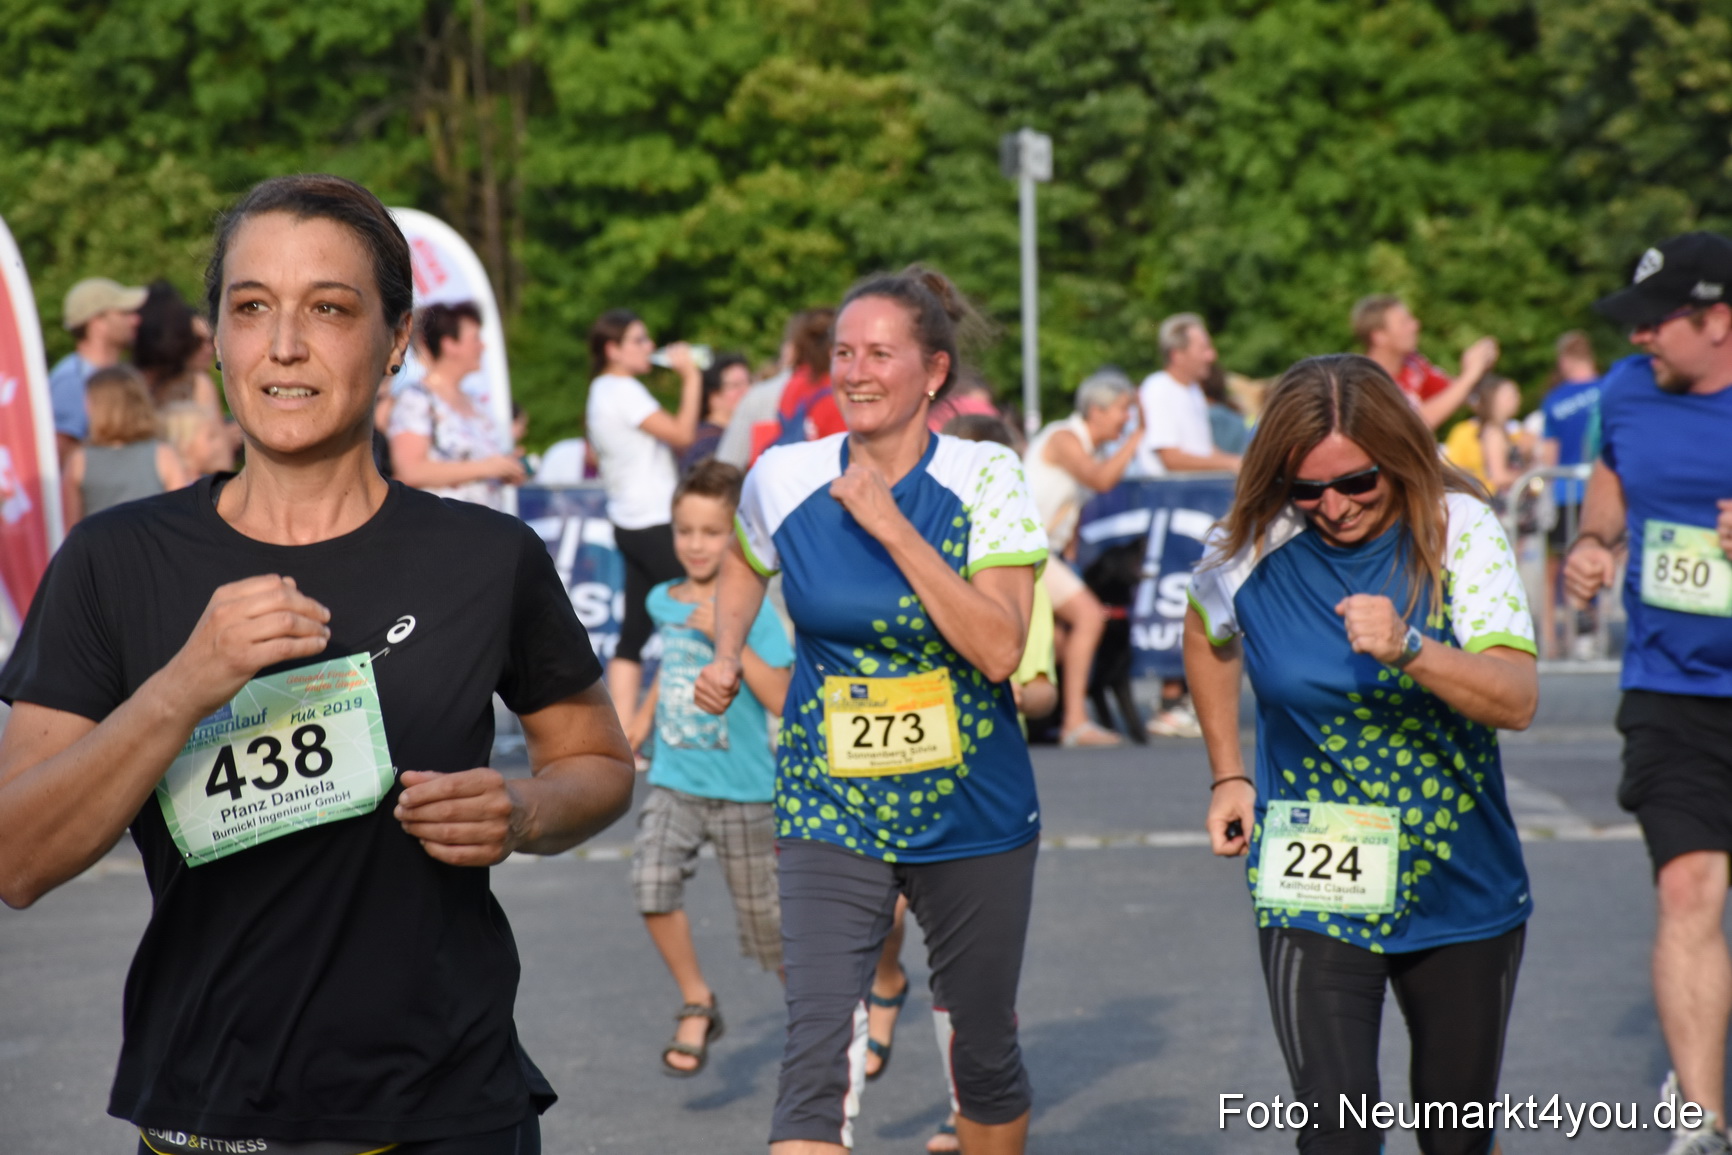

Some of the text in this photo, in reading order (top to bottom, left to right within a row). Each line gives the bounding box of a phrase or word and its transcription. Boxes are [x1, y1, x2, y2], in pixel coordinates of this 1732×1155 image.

[1655, 553, 1710, 588] 850
[322, 696, 363, 717] 2019
[851, 712, 925, 748] 273
[204, 723, 333, 801] 438
[212, 818, 256, 842] Burnickl
[259, 802, 312, 826] Ingenieur
[314, 790, 352, 809] GmbH
[220, 780, 335, 824] Pfanz Daniela
[1283, 841, 1363, 882] 224
[1324, 882, 1366, 895] Claudia
